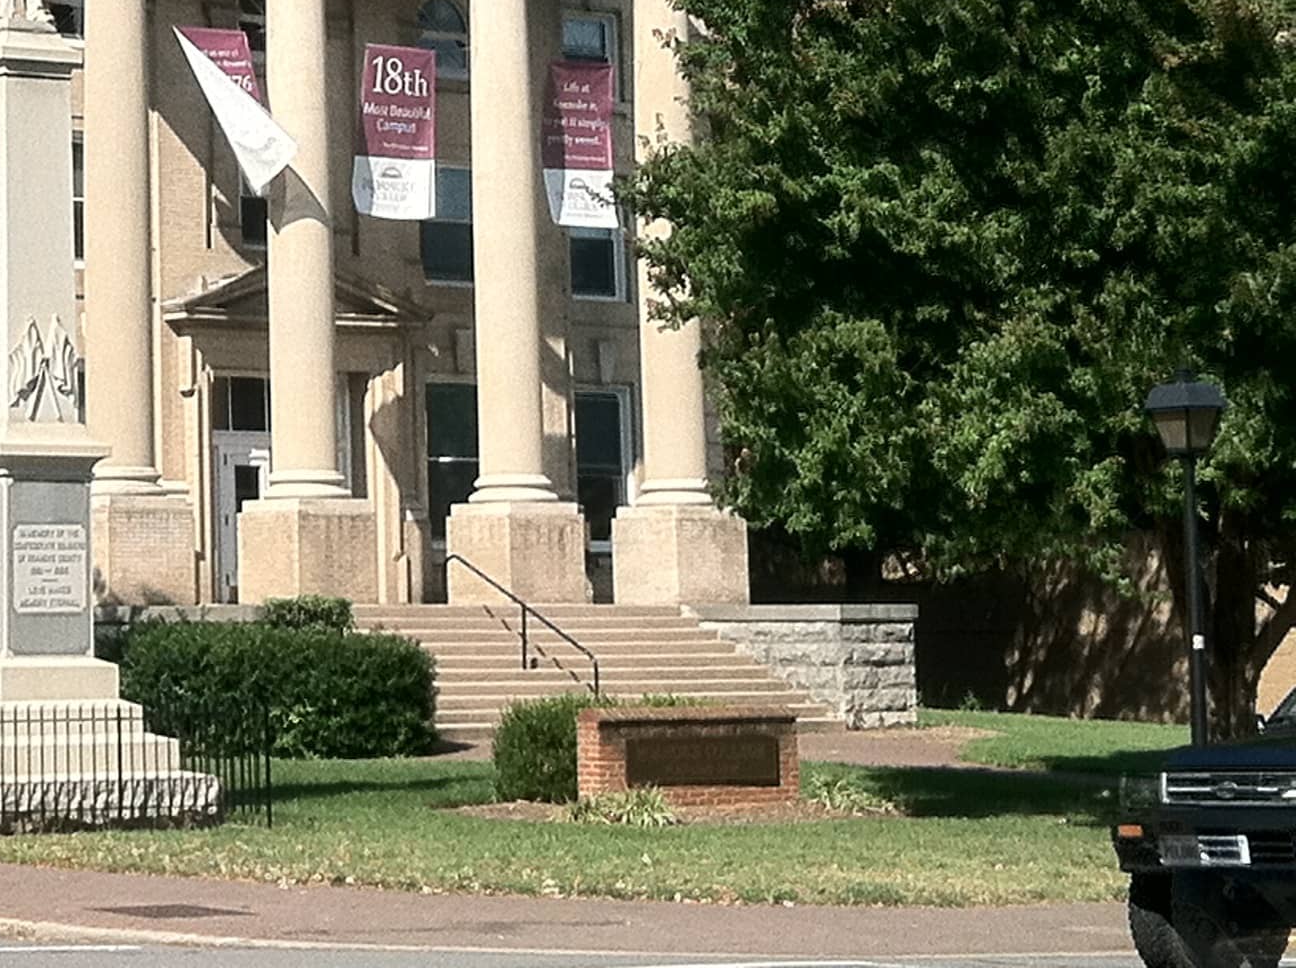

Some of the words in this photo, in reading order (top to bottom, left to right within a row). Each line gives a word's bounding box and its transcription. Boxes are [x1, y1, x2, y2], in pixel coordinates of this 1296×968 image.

[231, 75, 253, 92] 76
[372, 55, 429, 97] 18th
[364, 101, 388, 116] Most
[389, 105, 432, 121] Beautiful
[376, 118, 416, 134] Campus
